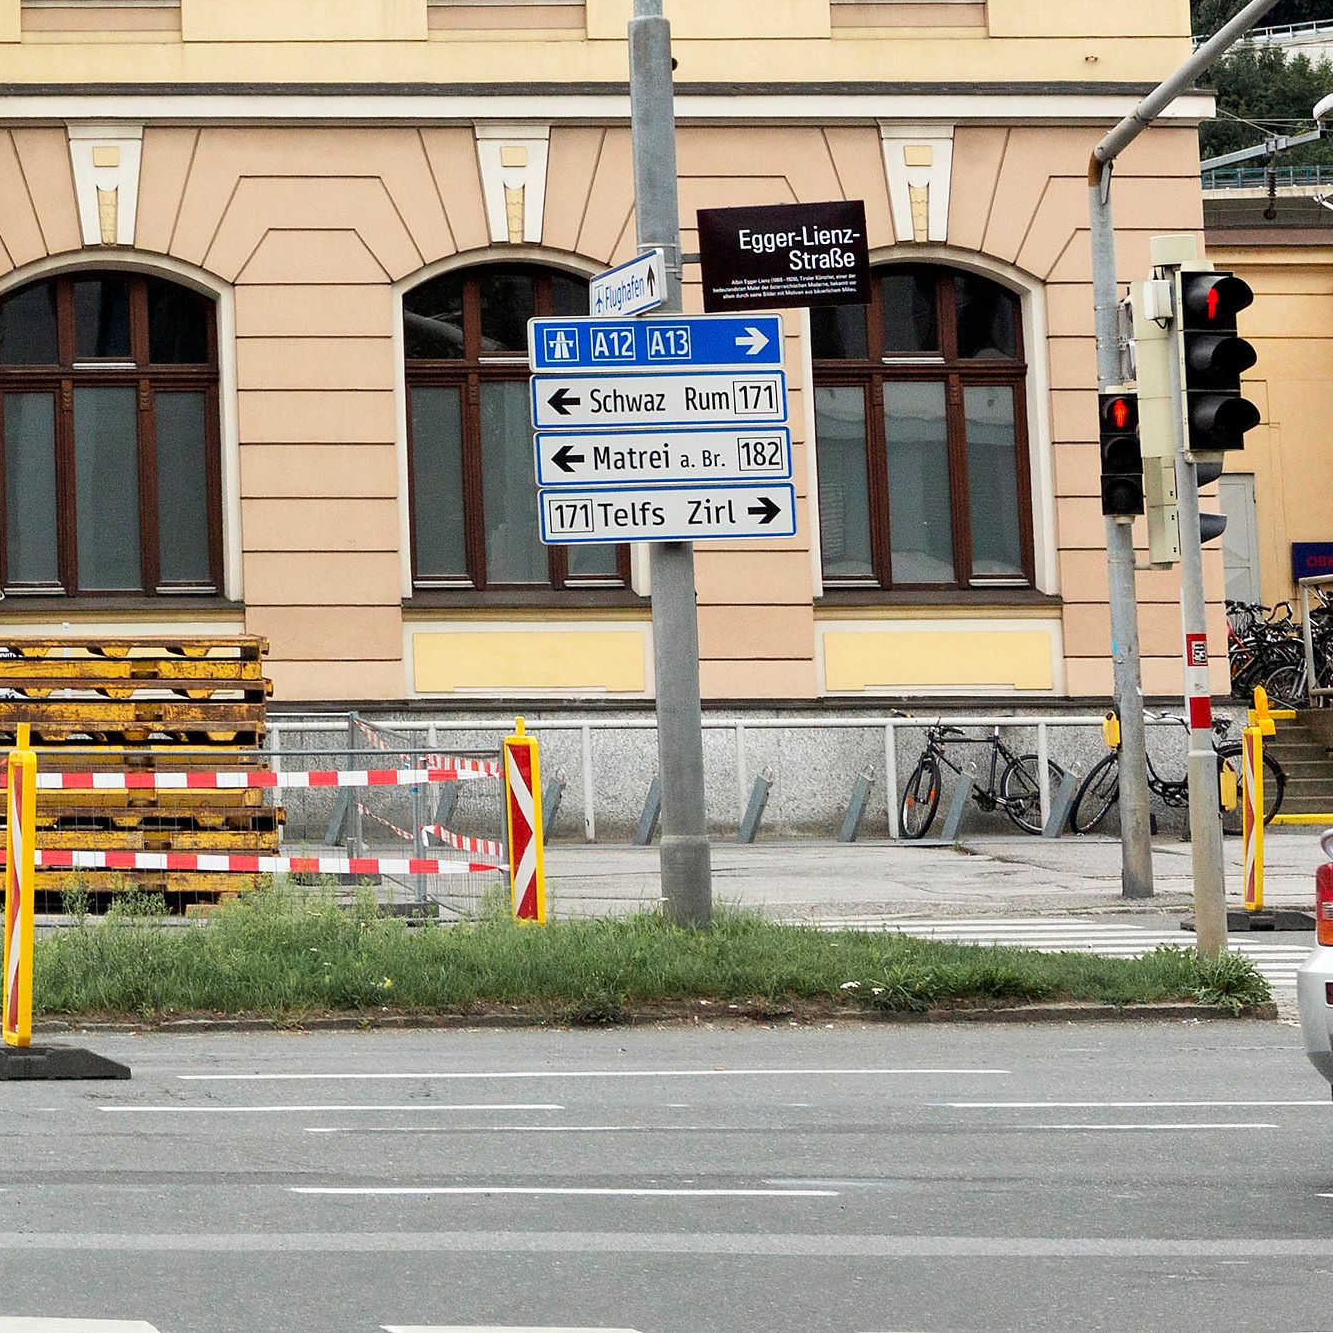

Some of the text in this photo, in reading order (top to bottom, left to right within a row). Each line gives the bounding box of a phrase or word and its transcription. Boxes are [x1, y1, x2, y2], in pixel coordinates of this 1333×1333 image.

[739, 225, 860, 254] Egger-Lienz-
[789, 248, 855, 271] Straße
[605, 274, 644, 311] Flughafen
[594, 330, 689, 357] A12 A13
[590, 385, 774, 413] Schwaz Rum 171
[593, 441, 780, 470] Matrei a. Br. 182
[554, 498, 736, 528] 171 Telfs Zirl
